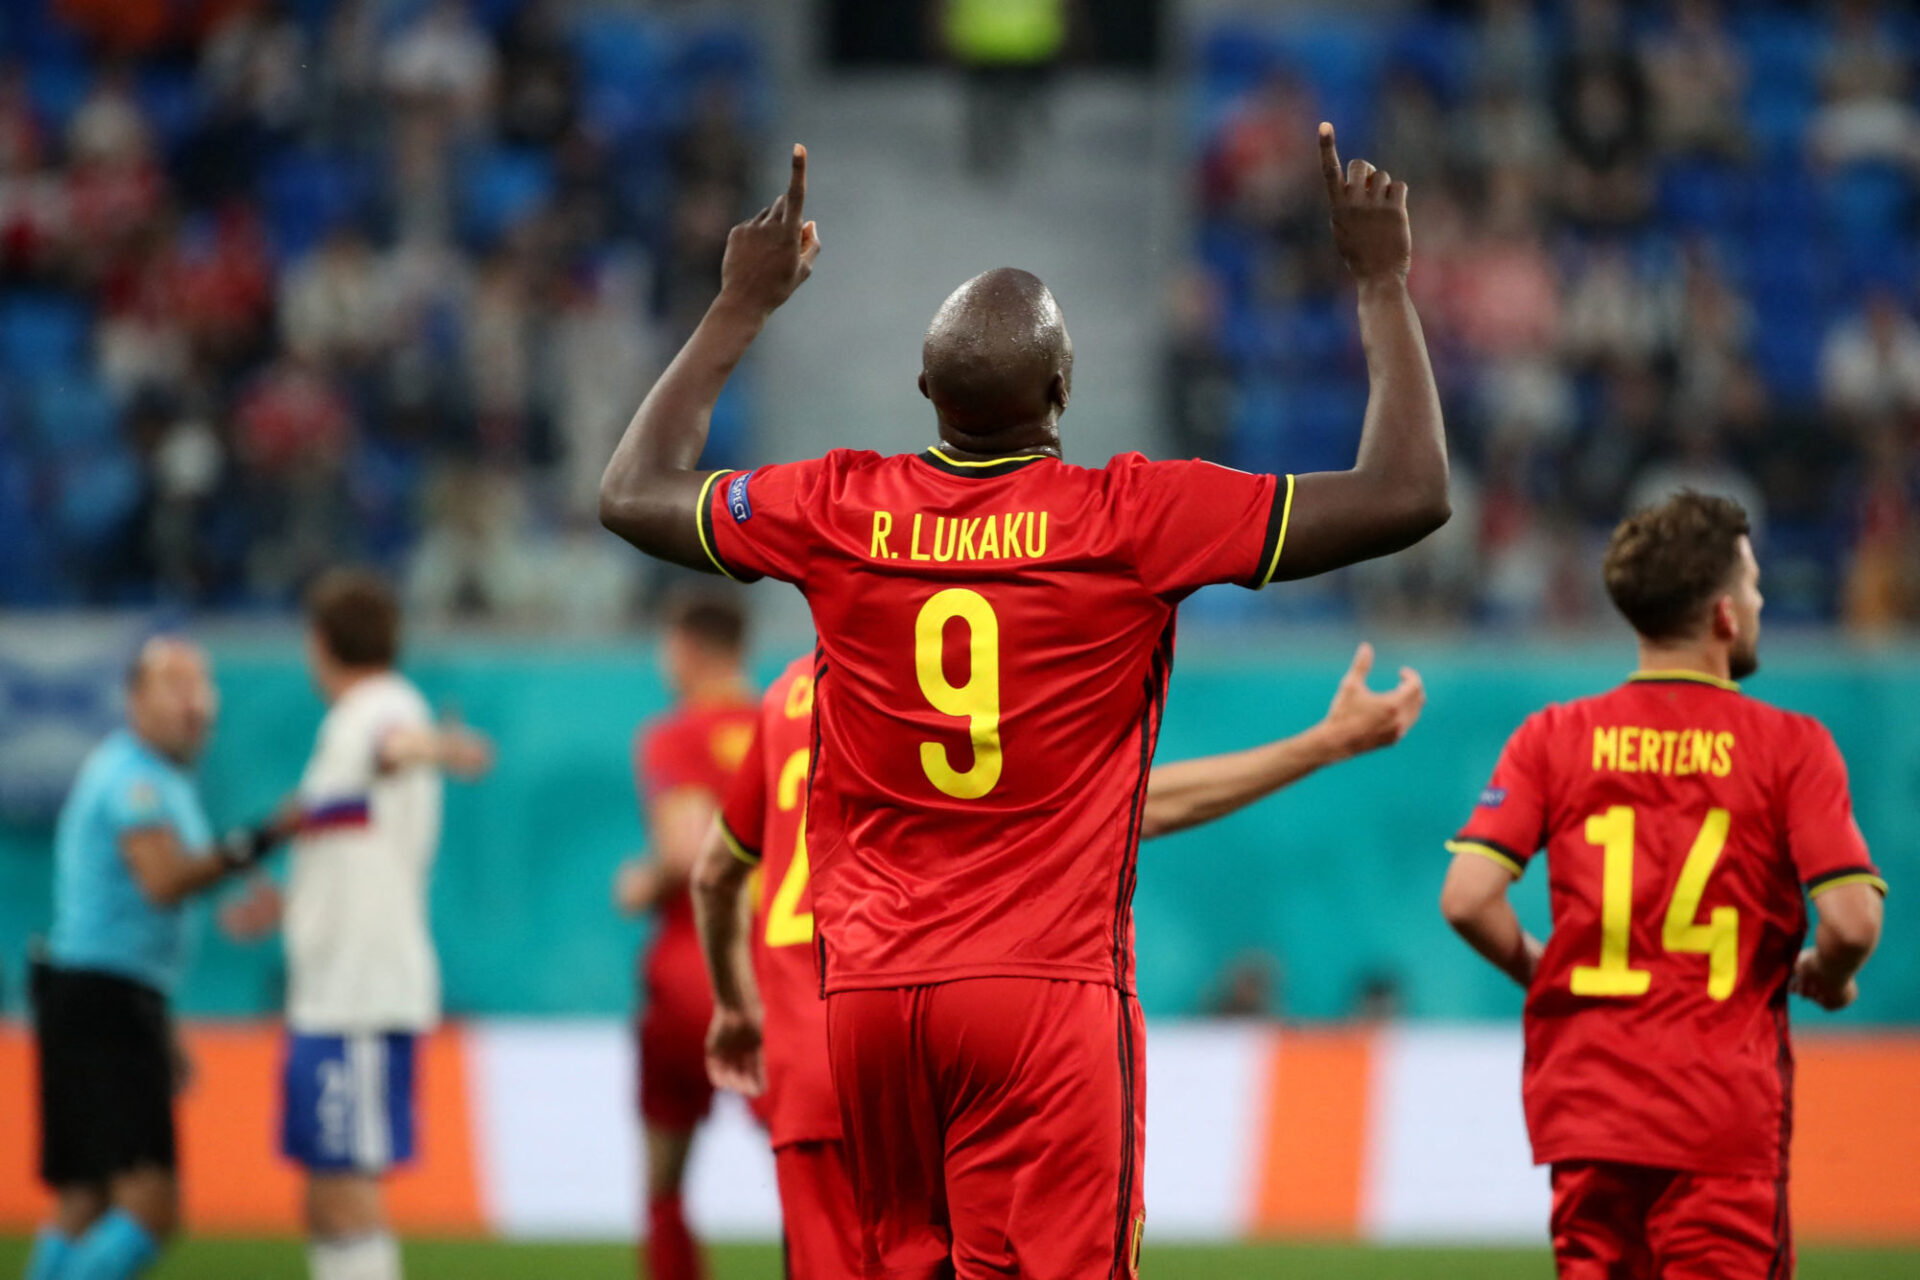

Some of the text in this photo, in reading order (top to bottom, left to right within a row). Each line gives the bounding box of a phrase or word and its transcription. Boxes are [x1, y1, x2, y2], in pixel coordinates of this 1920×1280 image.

[870, 511, 1048, 562] R. LUKAKU
[915, 588, 1003, 800] 9
[1592, 726, 1735, 777] MERTENS
[1570, 805, 1739, 1001] 14
